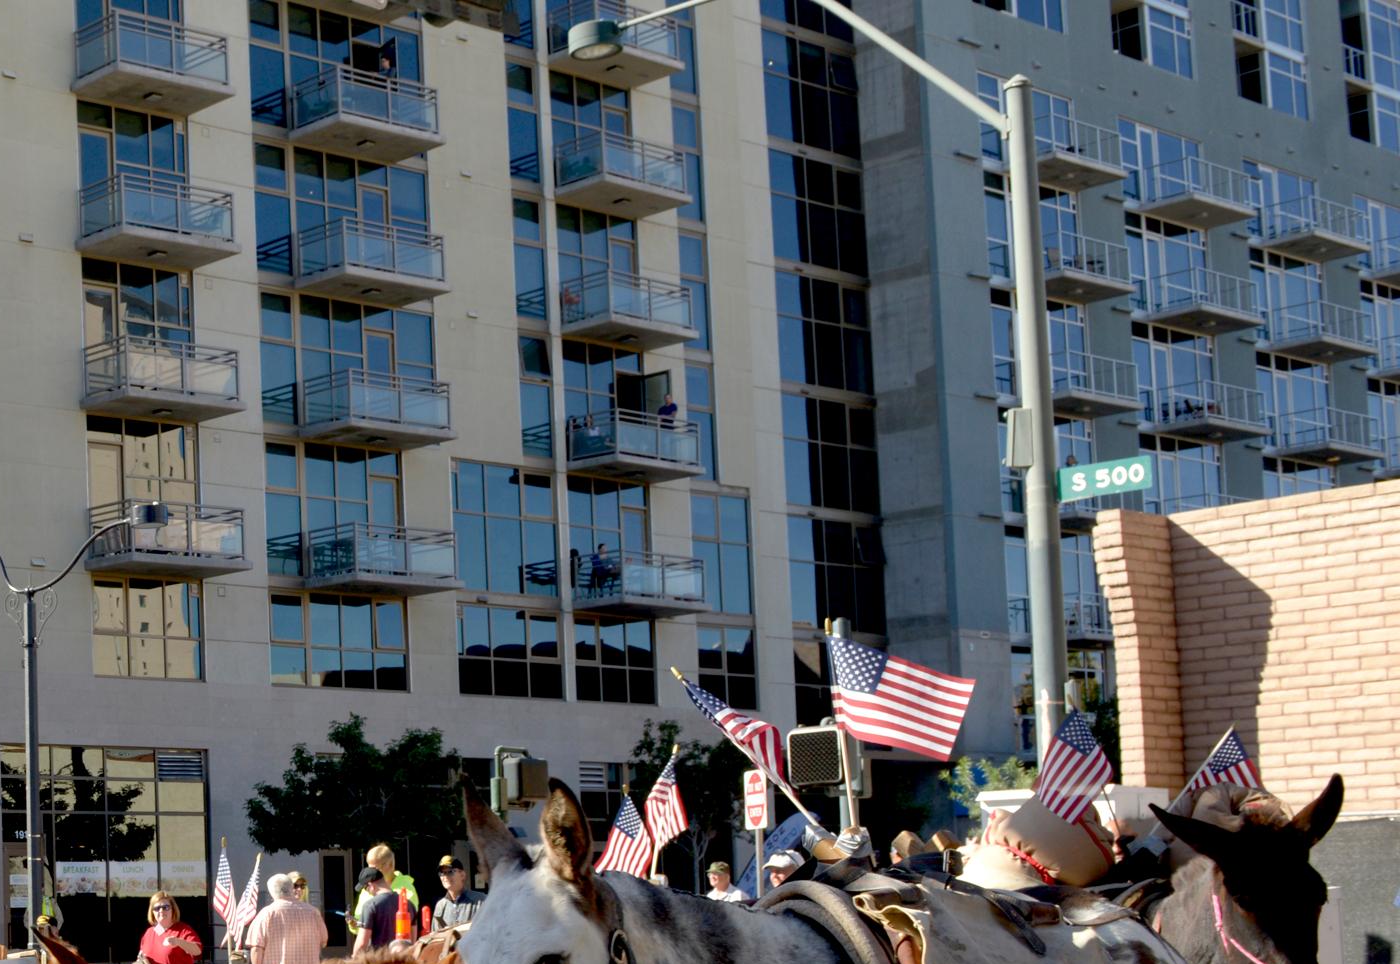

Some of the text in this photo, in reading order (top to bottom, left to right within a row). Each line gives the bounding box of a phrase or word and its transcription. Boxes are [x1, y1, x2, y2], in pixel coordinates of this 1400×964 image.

[1071, 463, 1145, 492] S 500
[62, 866, 99, 874] BREAKFAST
[122, 865, 144, 873] LUNCH
